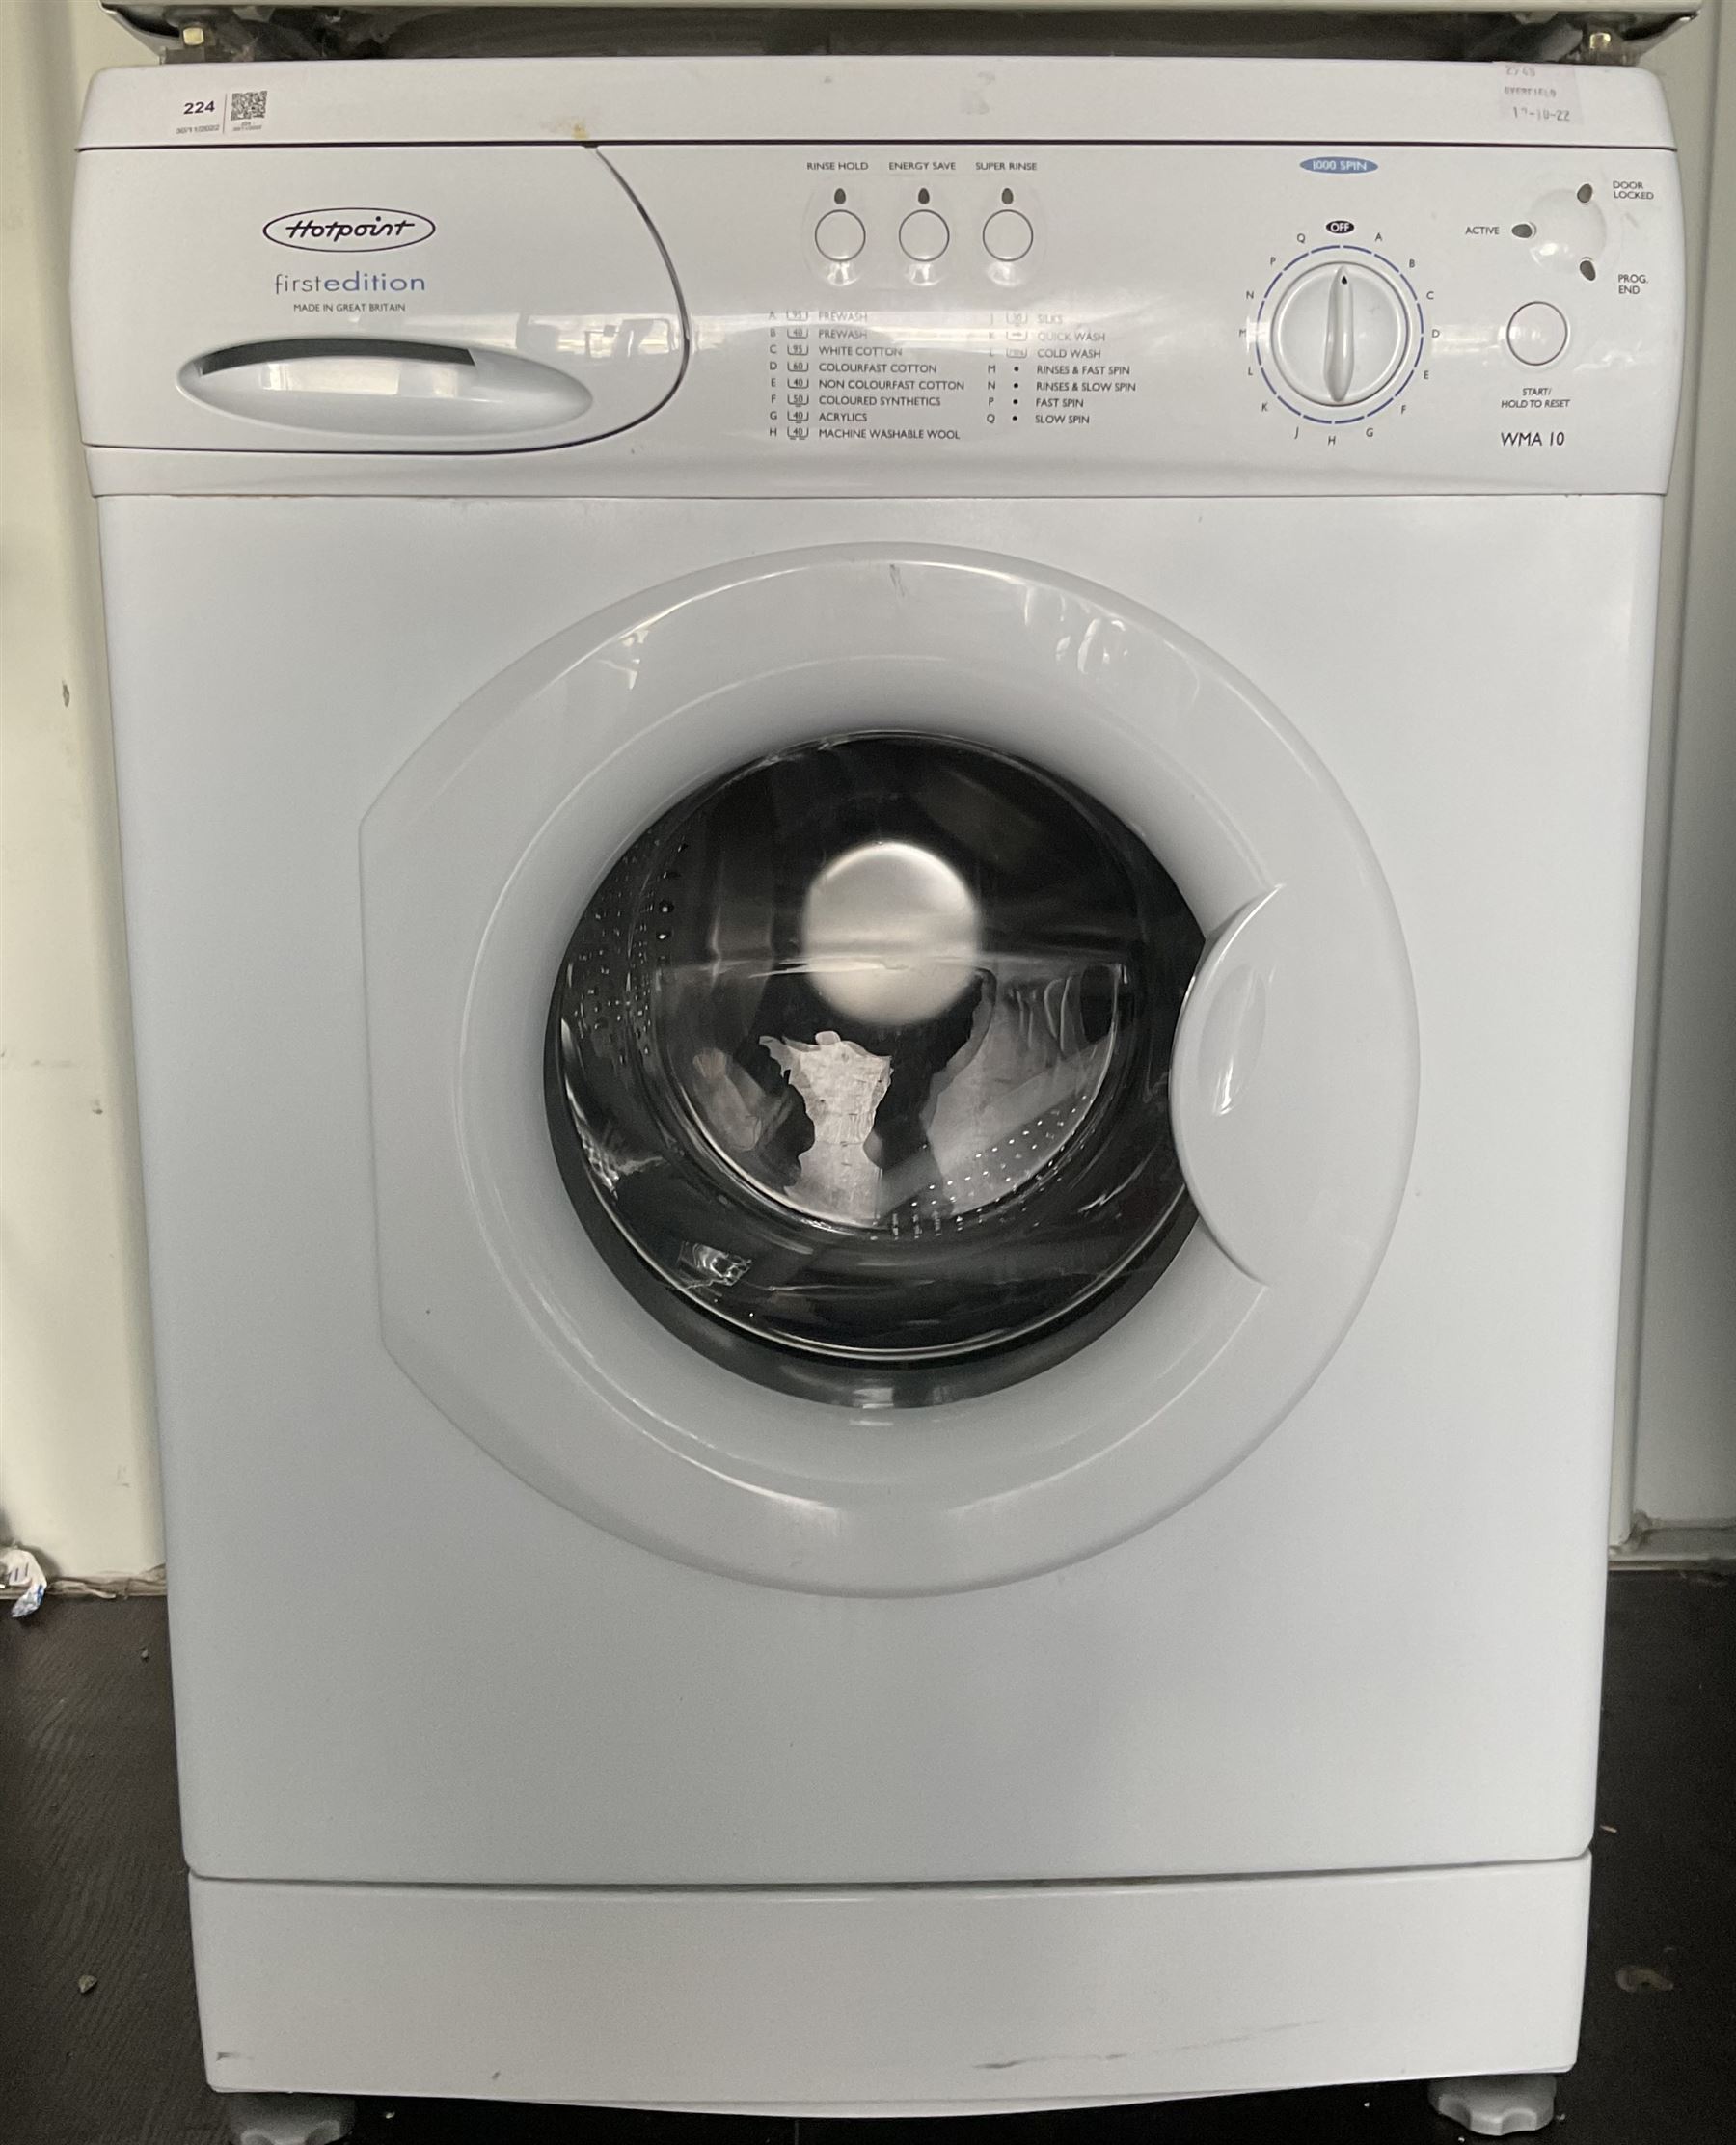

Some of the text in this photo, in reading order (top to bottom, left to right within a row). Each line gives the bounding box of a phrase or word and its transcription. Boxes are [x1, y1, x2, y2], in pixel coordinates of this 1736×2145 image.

[183, 100, 215, 115] 224
[806, 161, 869, 171] RINSE HOLD
[888, 161, 956, 171] ENERGY SAVE
[975, 162, 1037, 171] SUPER RINSE
[1313, 160, 1367, 171] 1000 SPIN
[1613, 180, 1643, 190] DOOR
[1614, 191, 1654, 200] LOCKED
[285, 215, 415, 242] Hotpoint
[1330, 222, 1349, 232] OFF
[1465, 227, 1500, 235] ACTIVE
[1296, 233, 1306, 244] Q
[1374, 232, 1383, 242] A
[1270, 257, 1276, 265] P
[1409, 259, 1416, 268] B
[1618, 274, 1649, 284] PROG.
[1246, 290, 1254, 299] N
[1618, 285, 1641, 294] END
[1426, 291, 1434, 300] C
[293, 303, 405, 312] MADE IN GREAT BRITAIN
[768, 311, 777, 320] A
[819, 312, 867, 322] PREWASH
[770, 328, 776, 338] B
[819, 329, 867, 339] PREWASH
[1038, 333, 1071, 342] QUICK
[1075, 333, 1105, 341] WASH
[1431, 329, 1440, 339] D
[769, 345, 777, 354] C
[819, 346, 853, 356] WHITE
[855, 346, 903, 357] COTTON
[1038, 348, 1067, 359] COLD
[1071, 349, 1101, 359] WASH
[769, 362, 778, 370] D
[819, 363, 887, 373] COLOURFAST
[890, 364, 937, 373] COTTON
[988, 365, 1130, 375] M RINSES & FAST SPIN
[1424, 370, 1429, 379] E
[771, 378, 776, 388] E
[819, 379, 844, 390] NON
[848, 380, 915, 390] COLOURFAST
[918, 381, 964, 391] COTTON
[988, 381, 1136, 392] N RINSES & SLOW SPIN
[771, 394, 776, 404] F
[819, 395, 877, 406] COLOURED
[880, 396, 941, 406] SYNTHETICS
[989, 397, 1084, 408] P FAST SPIN
[1501, 399, 1571, 408] HOLD TO RESET
[1261, 403, 1268, 412] K
[1401, 405, 1407, 414] F
[769, 411, 778, 421] G
[819, 413, 868, 422] ACRYLICS
[987, 414, 1090, 423] Q SLOW SPIN
[769, 427, 777, 437] H
[819, 428, 867, 439] MACHINE
[870, 429, 924, 439] WASHABLE
[927, 429, 961, 440] WOOL
[1366, 428, 1373, 437] G
[1328, 436, 1336, 446] H
[1501, 432, 1565, 447] WMA 10
